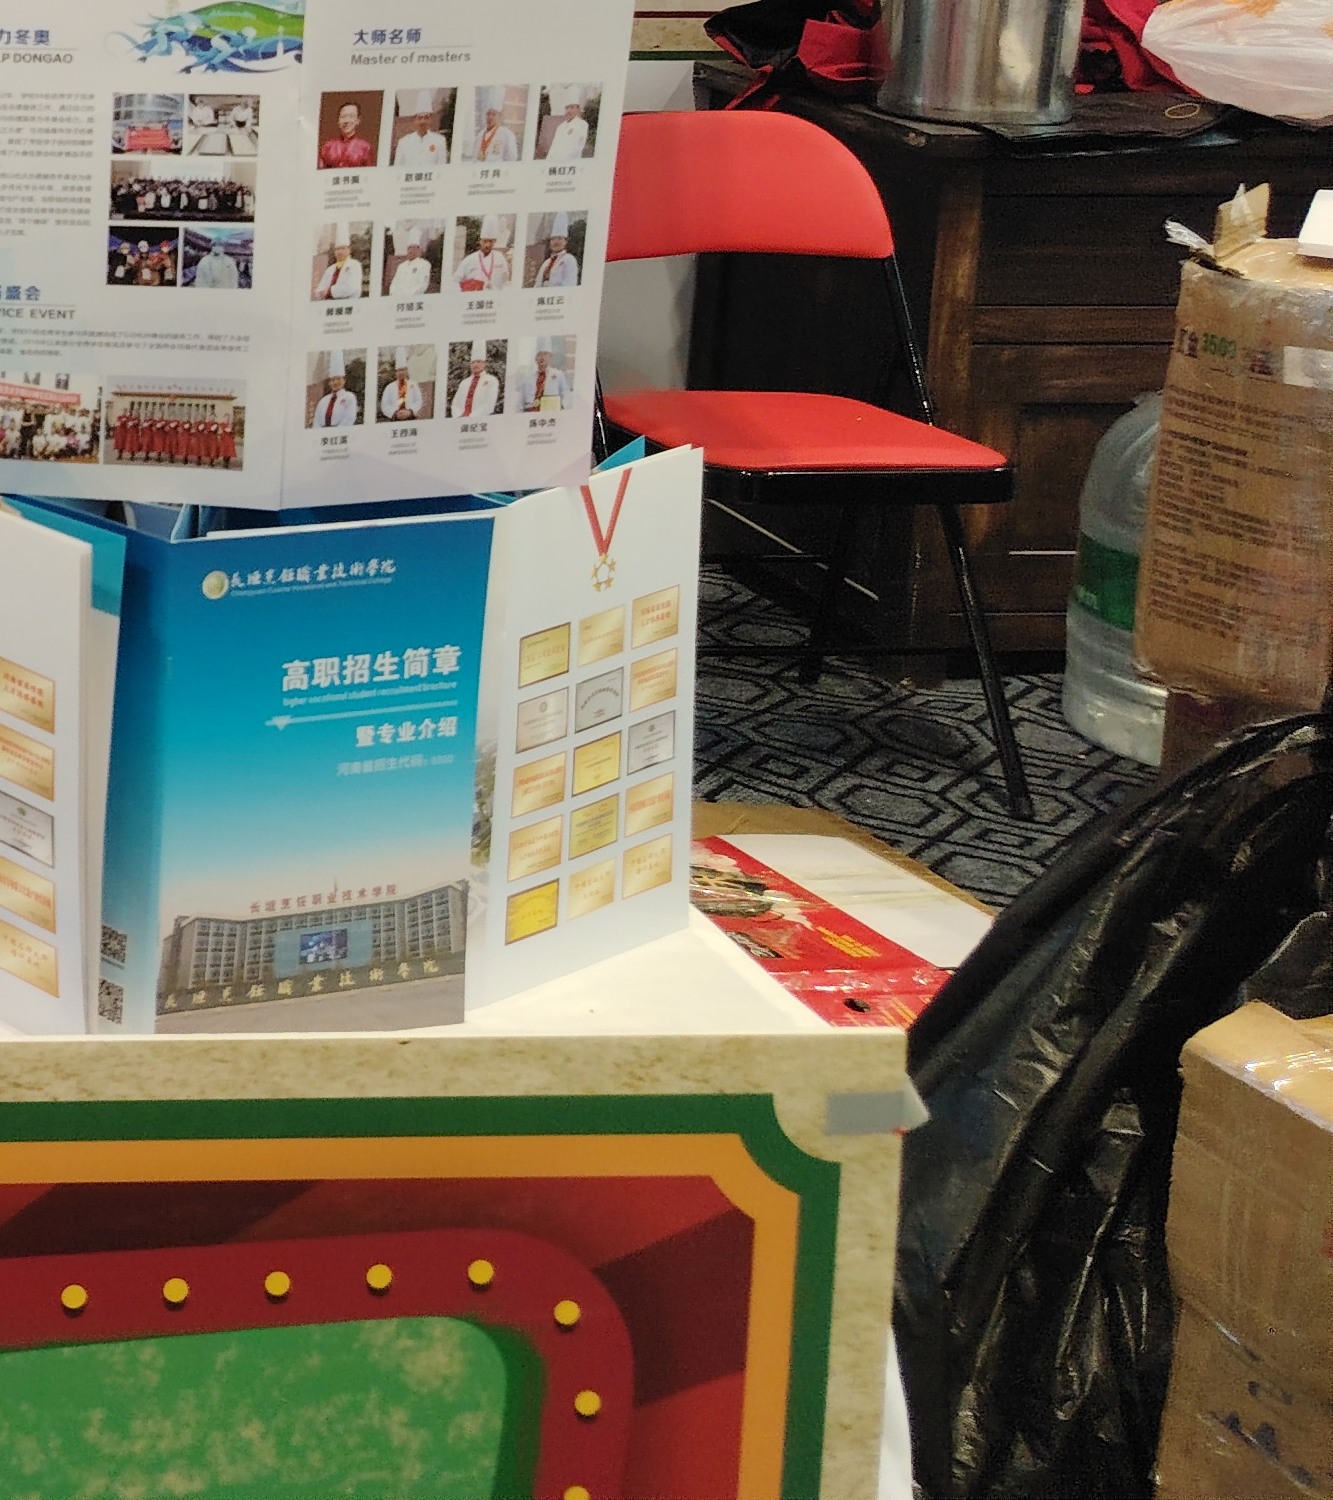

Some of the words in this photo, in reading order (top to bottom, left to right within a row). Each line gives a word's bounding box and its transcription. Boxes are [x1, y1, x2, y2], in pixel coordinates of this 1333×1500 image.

[352, 27, 422, 46] 大师名师
[12, 52, 75, 65] DONGAO
[350, 52, 399, 66] Master
[400, 50, 416, 65] of
[416, 51, 472, 64] masters
[29, 308, 77, 321] EVENT
[281, 643, 462, 692] 高职招生简章
[355, 716, 459, 748] 暨专业介绍
